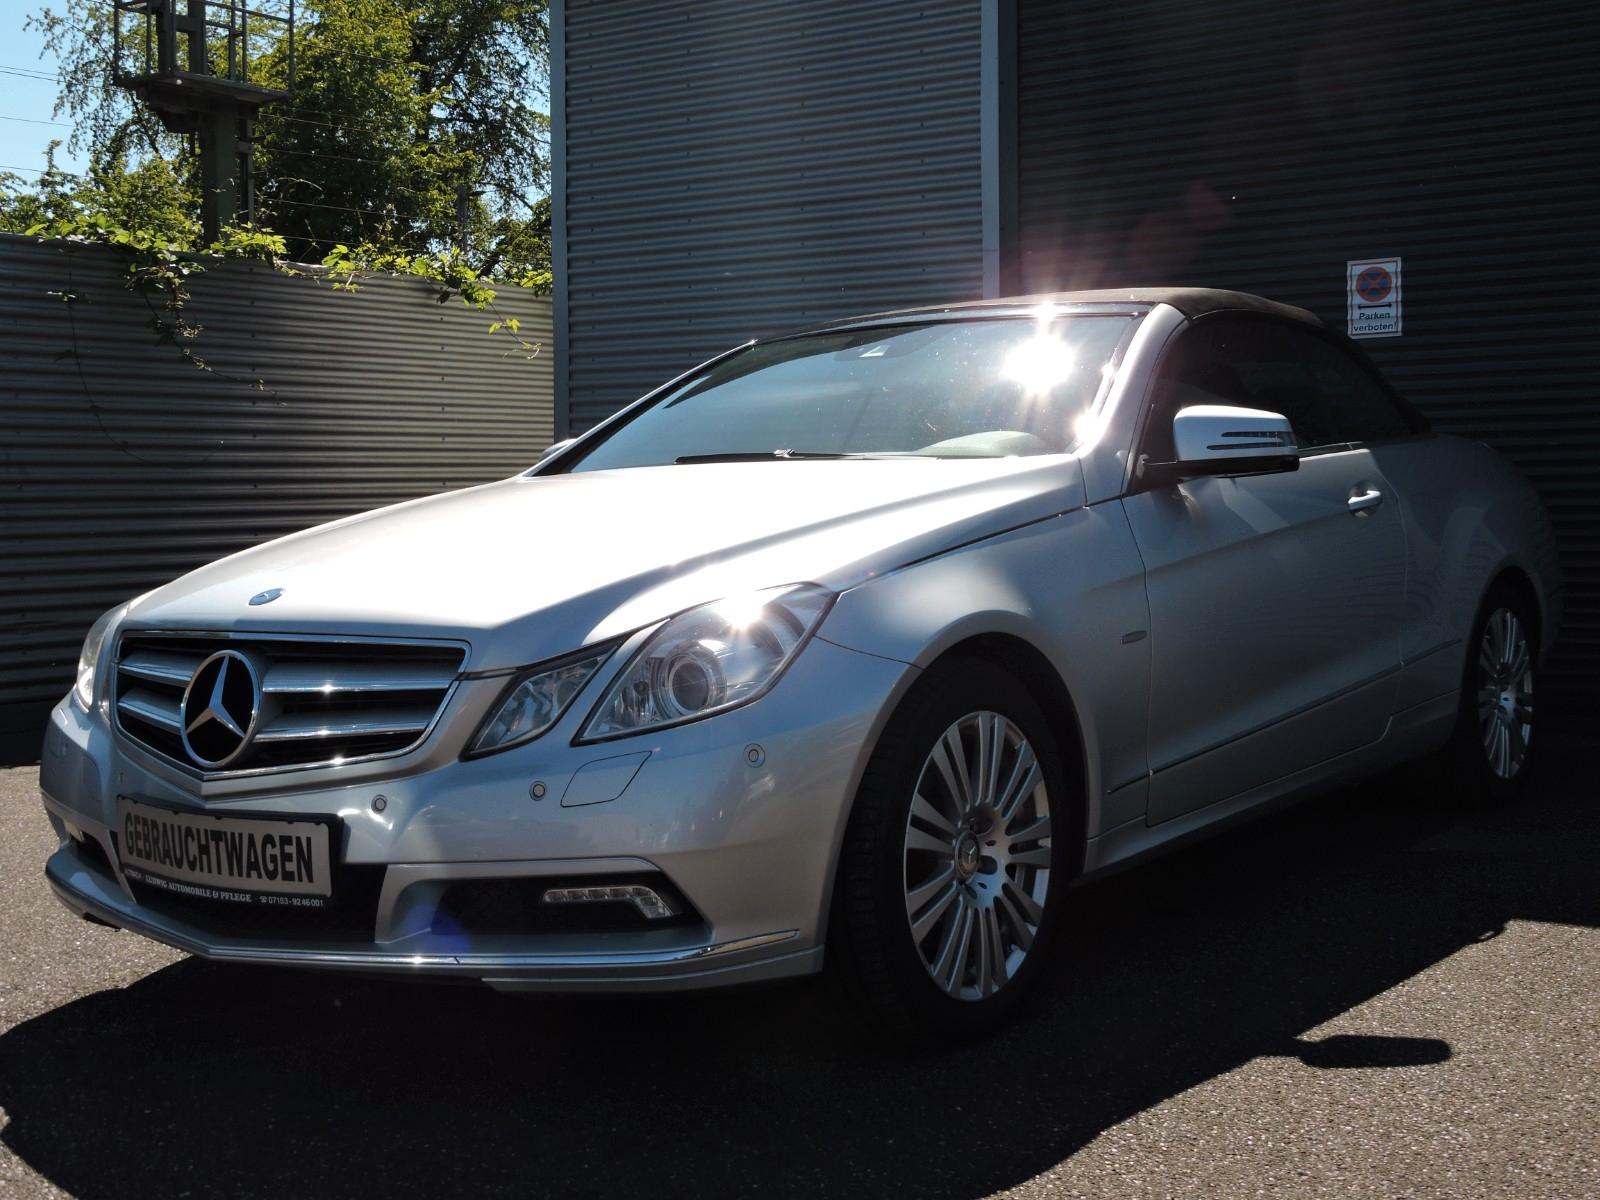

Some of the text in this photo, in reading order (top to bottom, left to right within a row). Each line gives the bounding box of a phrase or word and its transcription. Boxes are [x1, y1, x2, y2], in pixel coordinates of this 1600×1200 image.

[1359, 312, 1391, 320] Parken
[125, 811, 314, 883] GEBRAUCHTWAGEN
[145, 874, 168, 888] LUDWIG
[168, 881, 212, 898] AUTOMOBILE
[220, 891, 252, 902] PFLEGE
